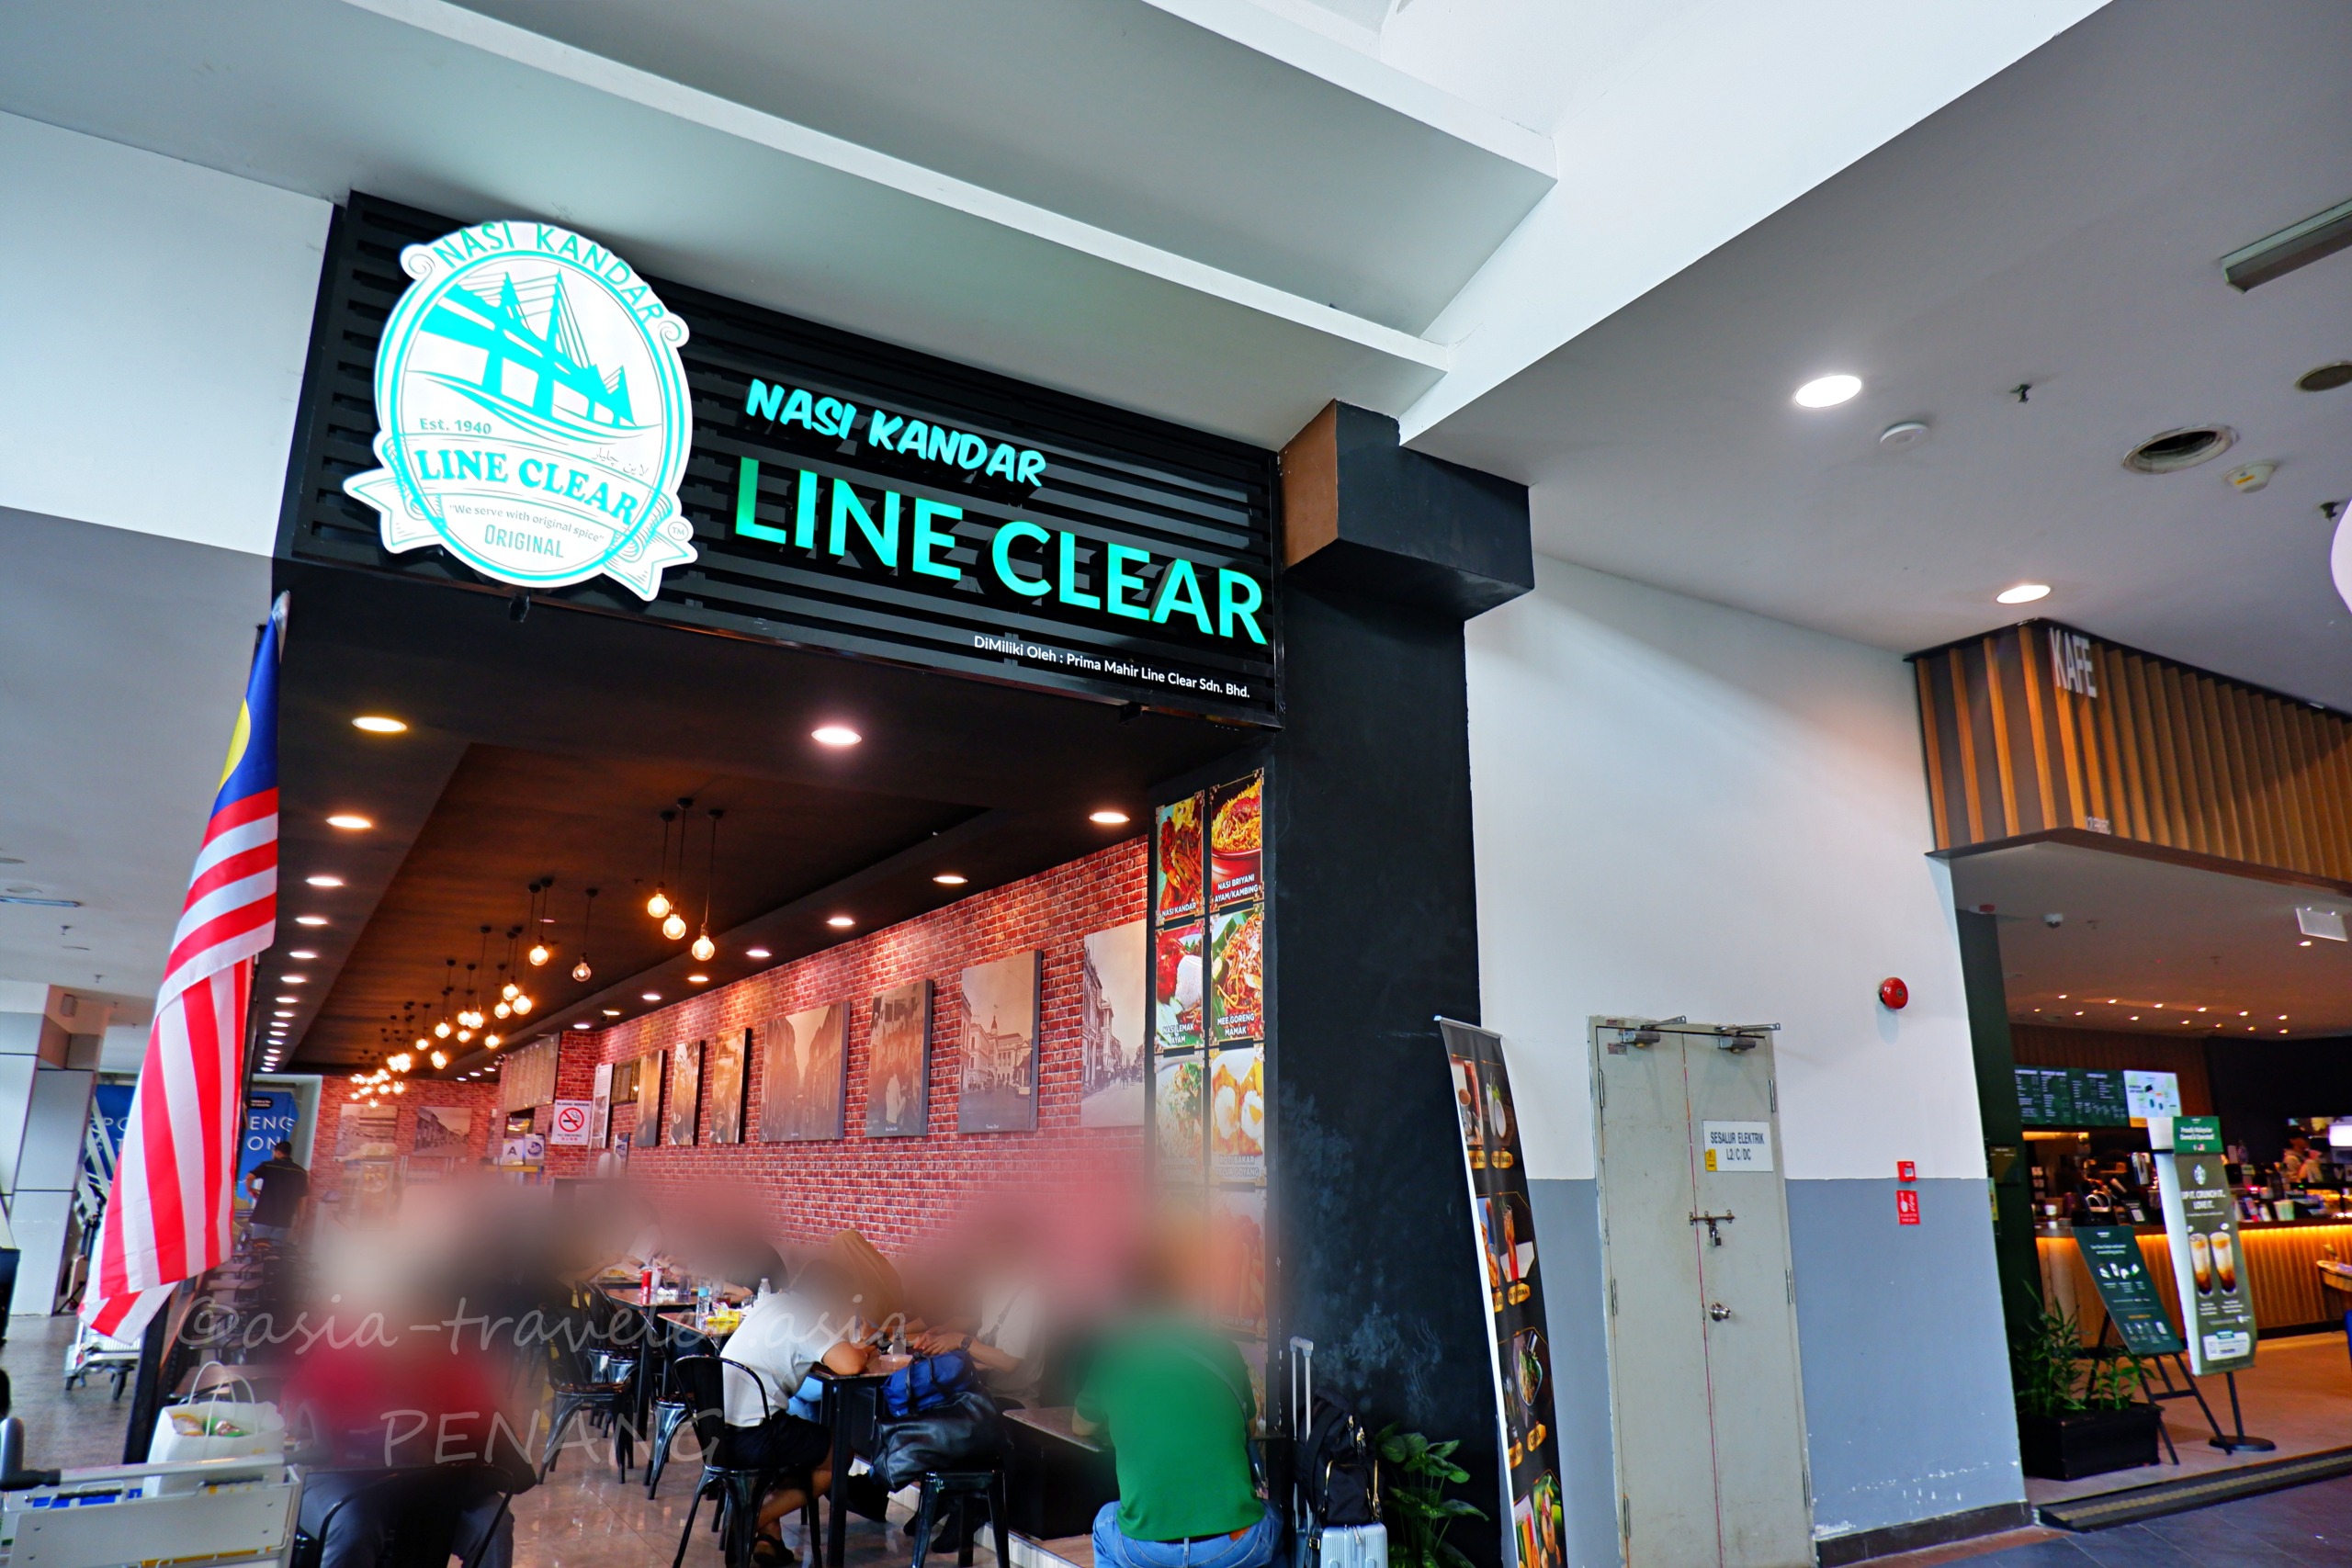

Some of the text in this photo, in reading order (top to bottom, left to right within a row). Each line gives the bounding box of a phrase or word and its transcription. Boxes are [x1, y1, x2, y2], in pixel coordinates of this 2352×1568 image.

[433, 221, 664, 322] NASI KANDAR
[420, 417, 492, 435] Est. 1940
[745, 378, 1046, 488] NASI KANDAR
[414, 449, 639, 525] LINE CLEAR
[474, 507, 503, 518] serve
[506, 510, 530, 522] with
[532, 515, 572, 532] original
[735, 457, 1268, 646] LINE CLEAR
[974, 635, 1023, 657] DiMiliki
[1026, 646, 1057, 663] Oleh
[1067, 653, 1102, 671] Prima
[1104, 660, 1138, 678] Mahir
[1141, 668, 1165, 683] Line
[1168, 673, 1197, 689] Clear
[1199, 679, 1223, 694] Sdn.
[1226, 684, 1250, 699] Bhd.
[2049, 627, 2098, 698] KAFE
[1217, 873, 1255, 891] NASI BRIYANI
[1161, 902, 1196, 917] NASI KANDAR
[1162, 1022, 1194, 1035] NASI LEMAK
[1217, 1012, 1255, 1026] MEE GORENG
[1225, 1025, 1247, 1037] MAMAK
[1710, 1131, 1765, 1145] SESALUR ELEKTRIK
